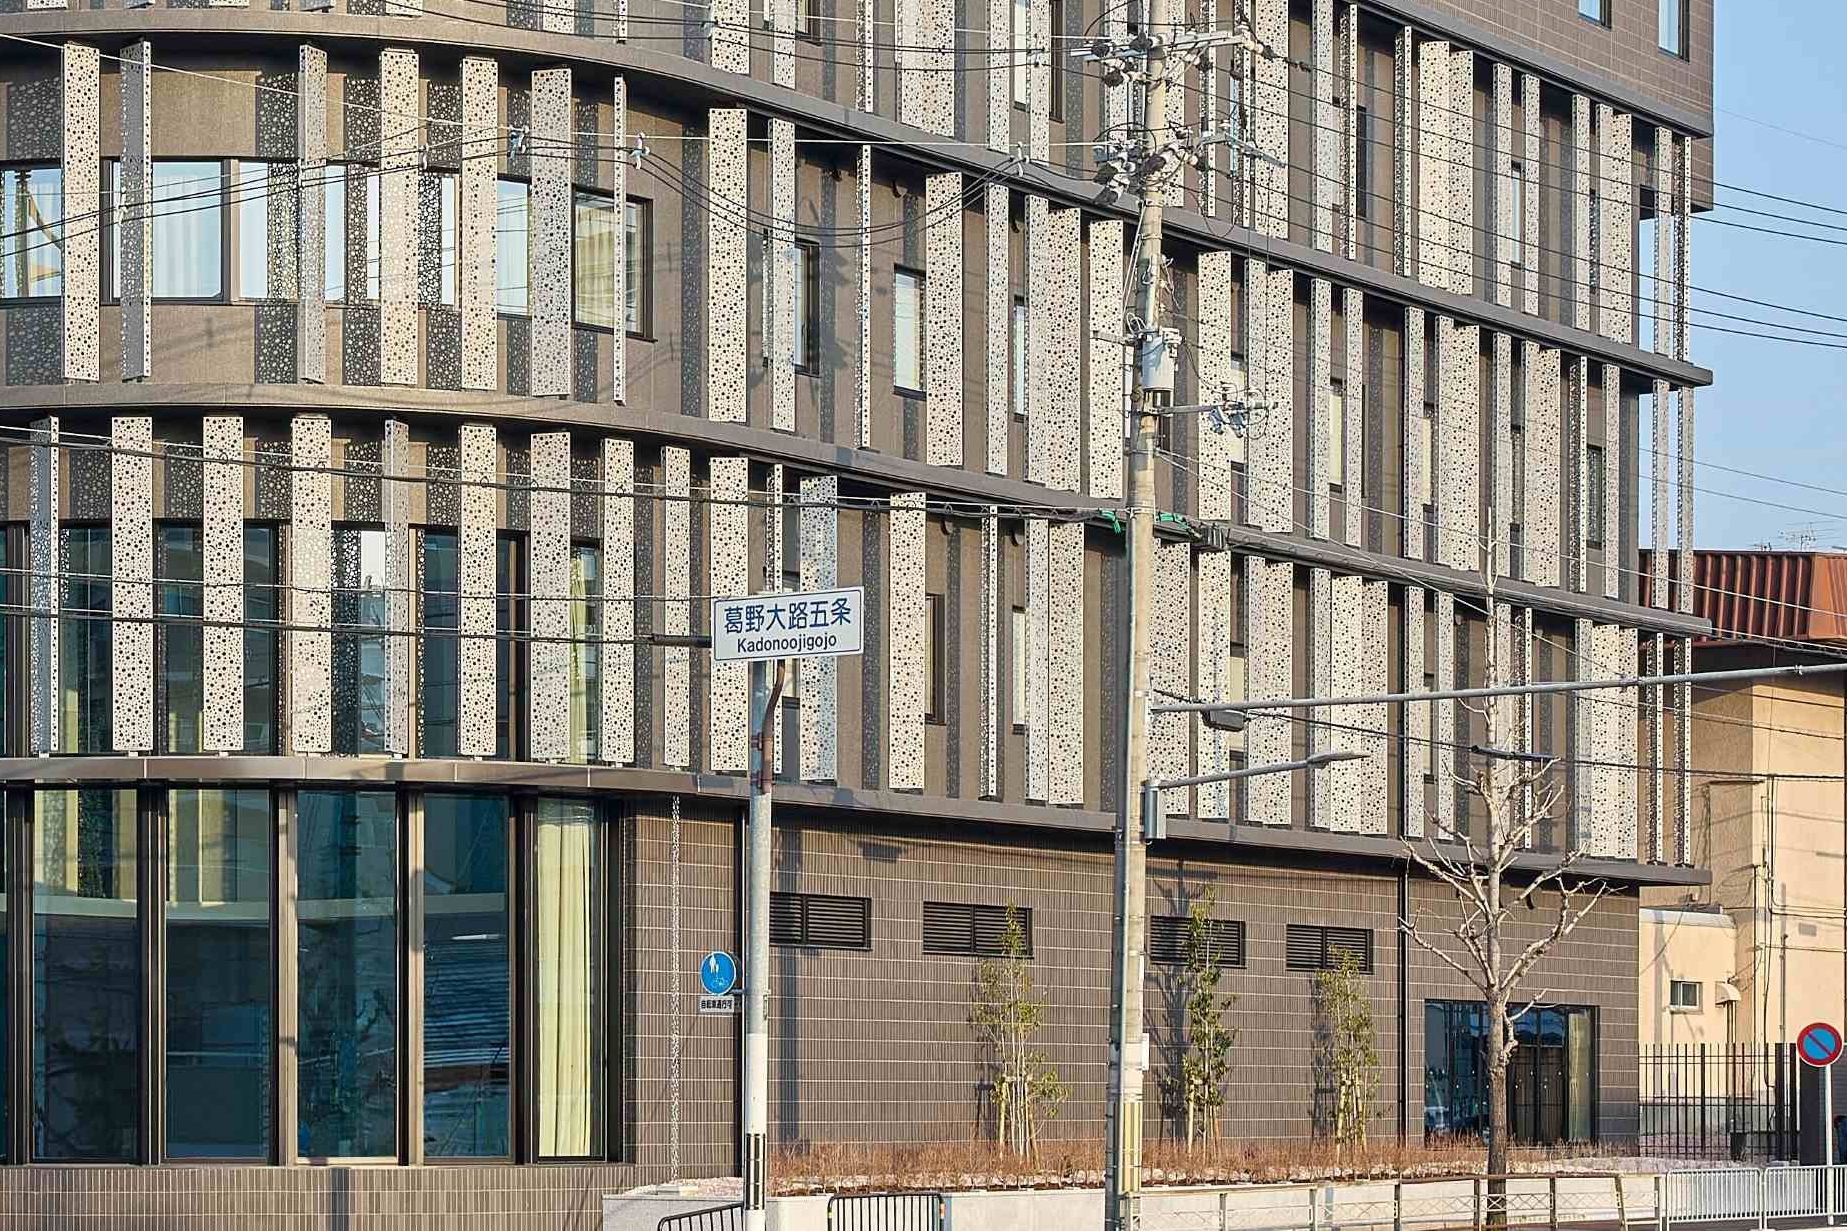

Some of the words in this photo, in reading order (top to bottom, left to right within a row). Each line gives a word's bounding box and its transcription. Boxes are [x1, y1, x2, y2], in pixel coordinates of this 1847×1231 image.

[724, 597, 852, 634] 葛野大路五条
[737, 633, 837, 653] Kadonoojigojo
